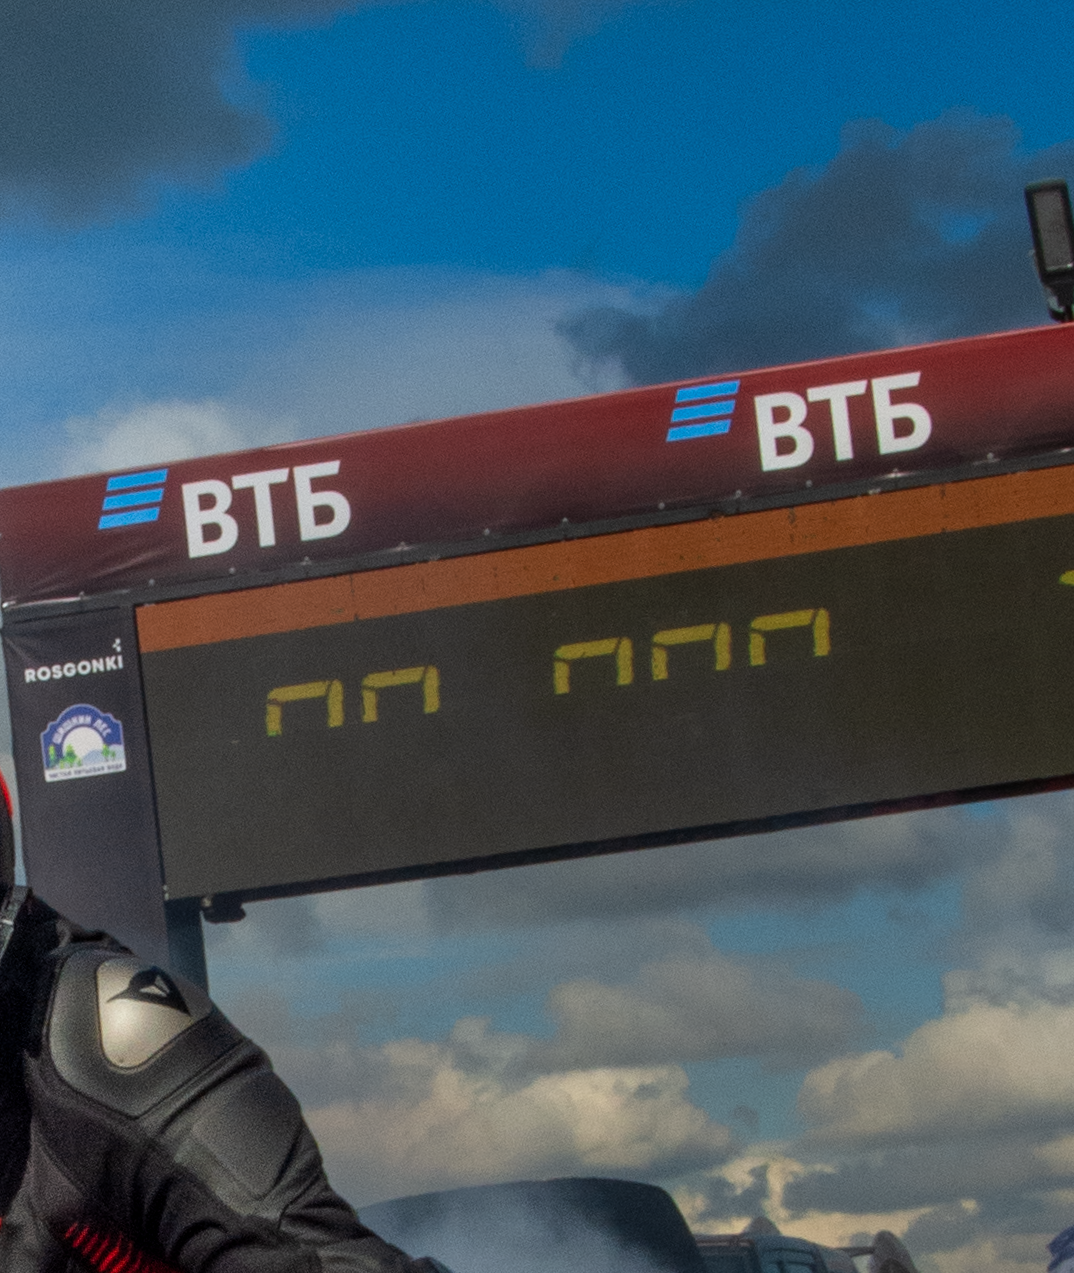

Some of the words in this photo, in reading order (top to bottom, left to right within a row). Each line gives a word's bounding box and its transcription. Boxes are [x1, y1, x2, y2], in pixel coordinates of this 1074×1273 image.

[755, 371, 933, 472] ВТБ
[181, 460, 353, 559] ВТБ
[24, 655, 123, 683] ROSGONKI
